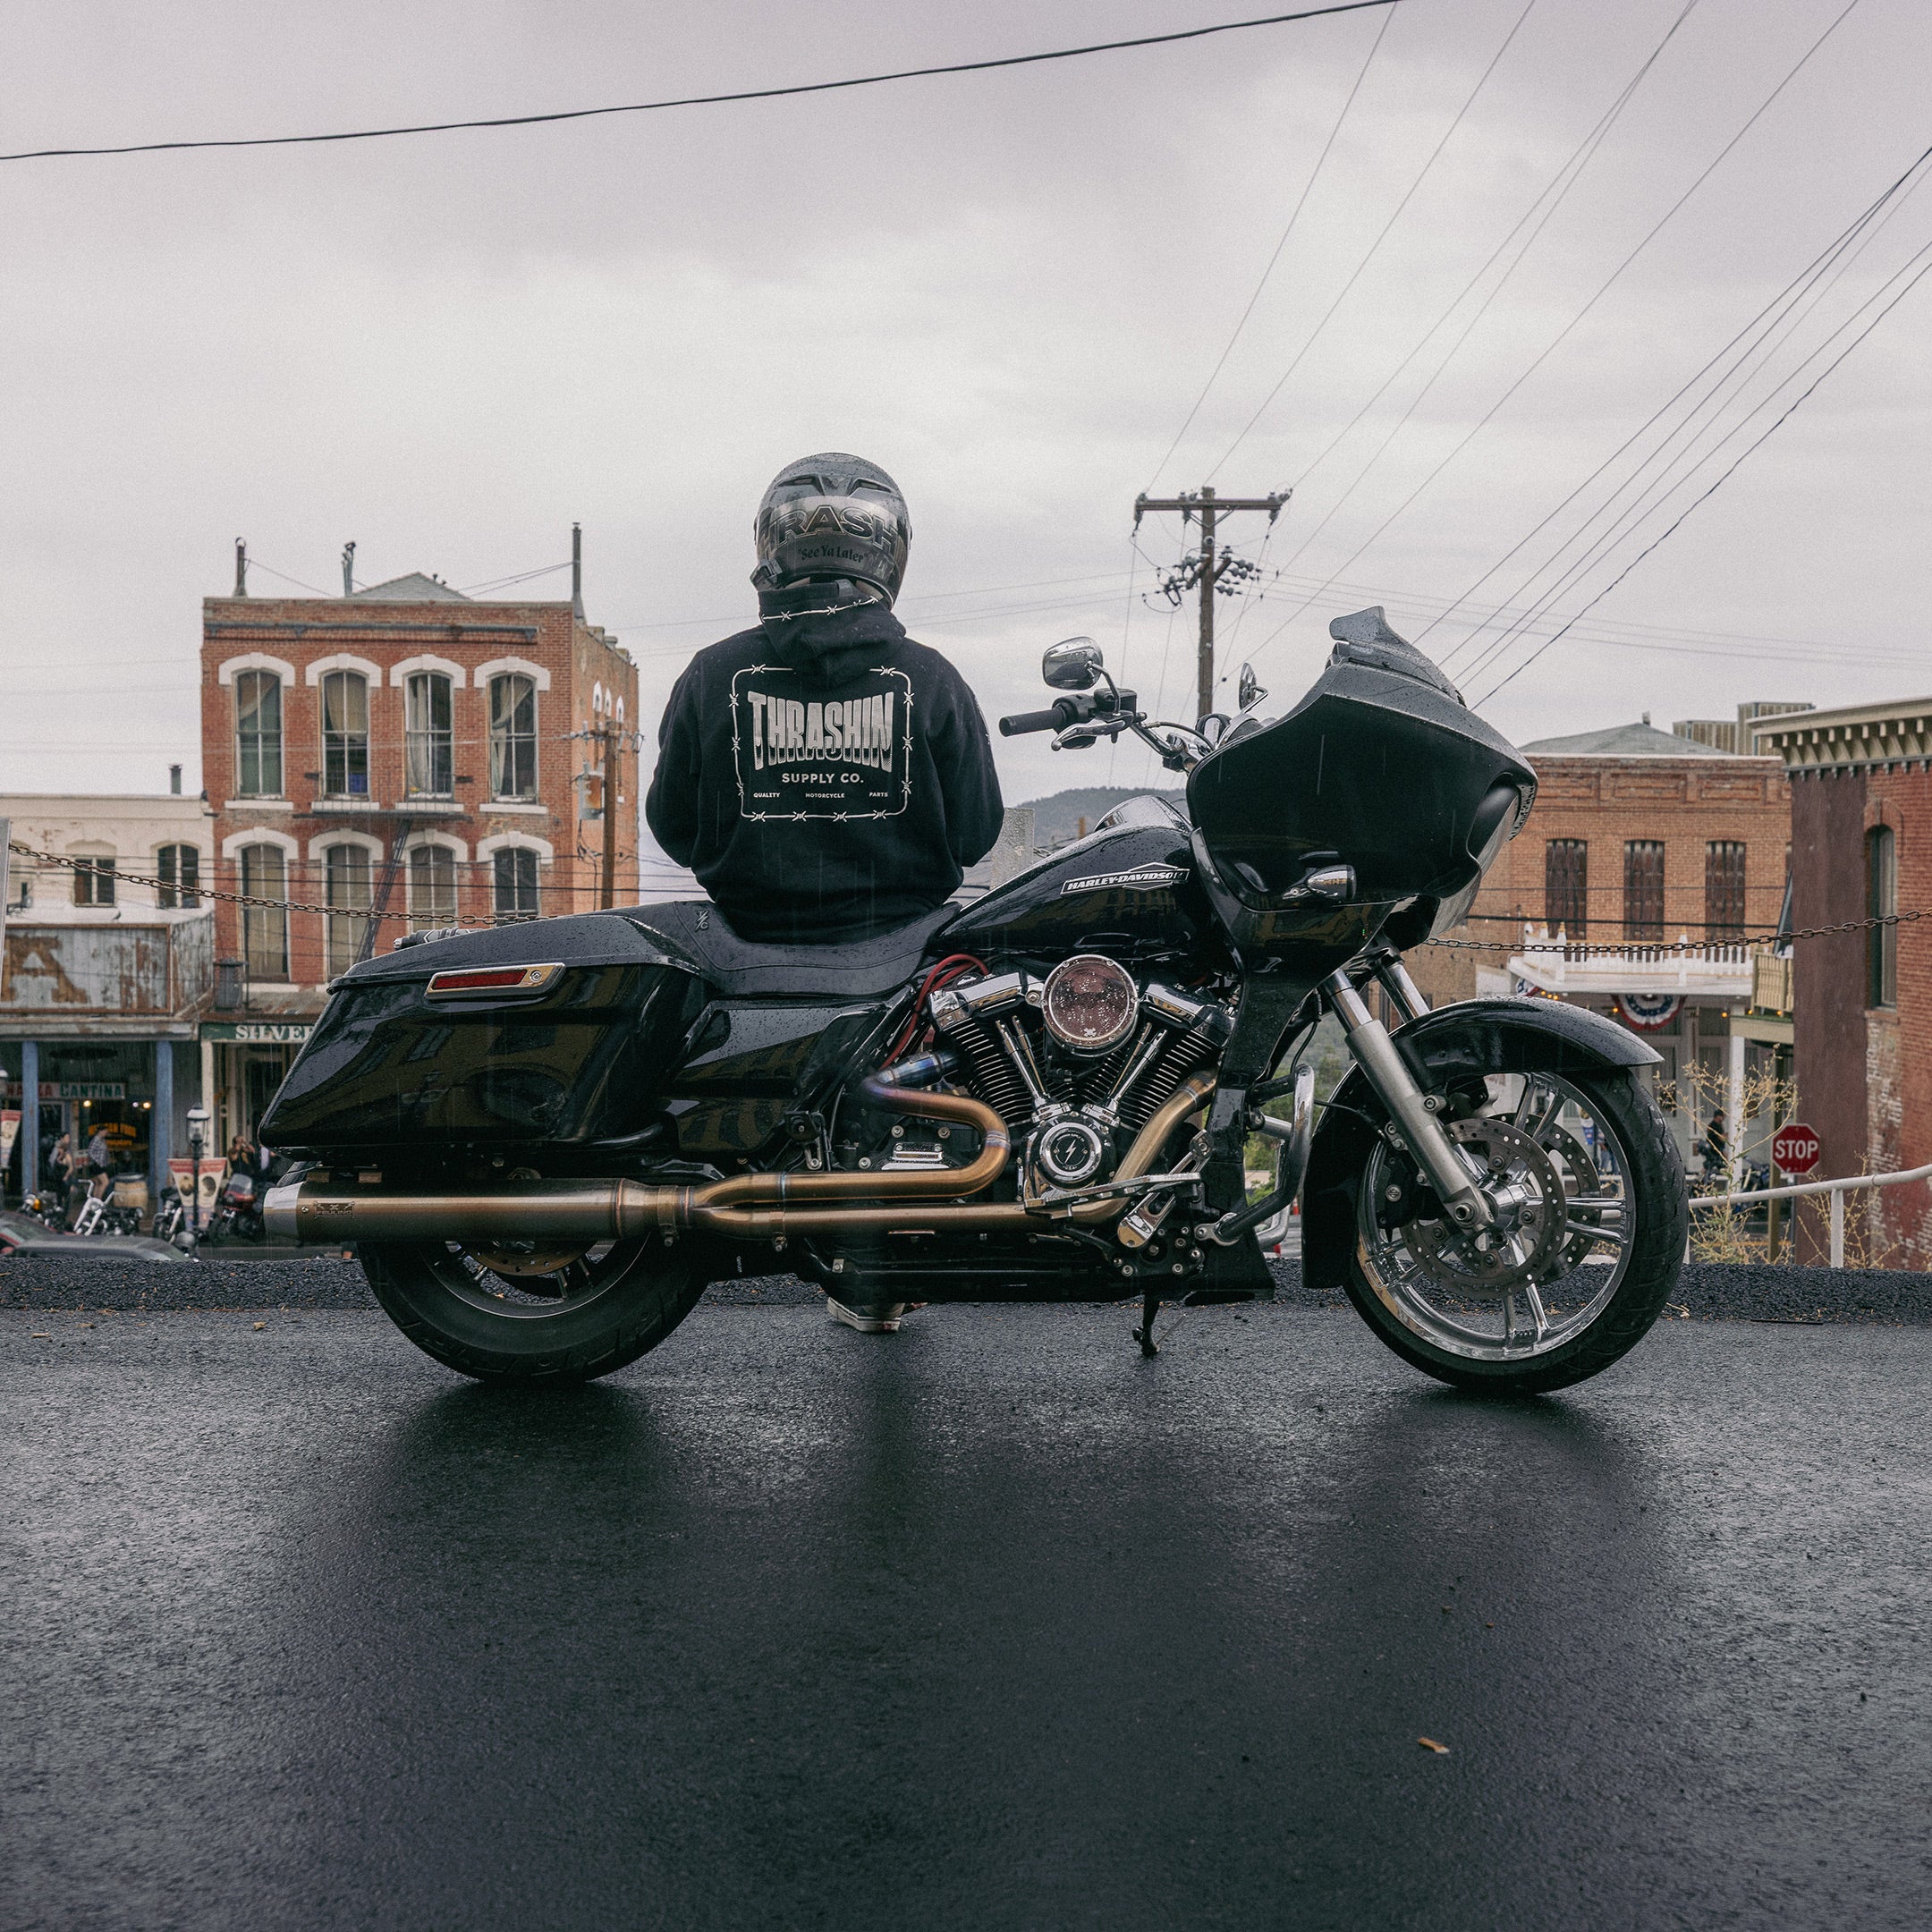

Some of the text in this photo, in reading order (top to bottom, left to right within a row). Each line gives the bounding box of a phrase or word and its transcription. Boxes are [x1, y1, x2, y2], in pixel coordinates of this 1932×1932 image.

[821, 545, 835, 557] Ya
[747, 691, 894, 773] THRASHIN
[782, 773, 865, 784] SUPPLY CO.
[60, 1082, 123, 1097] CANTINA
[1775, 1140, 1818, 1159] STOP
